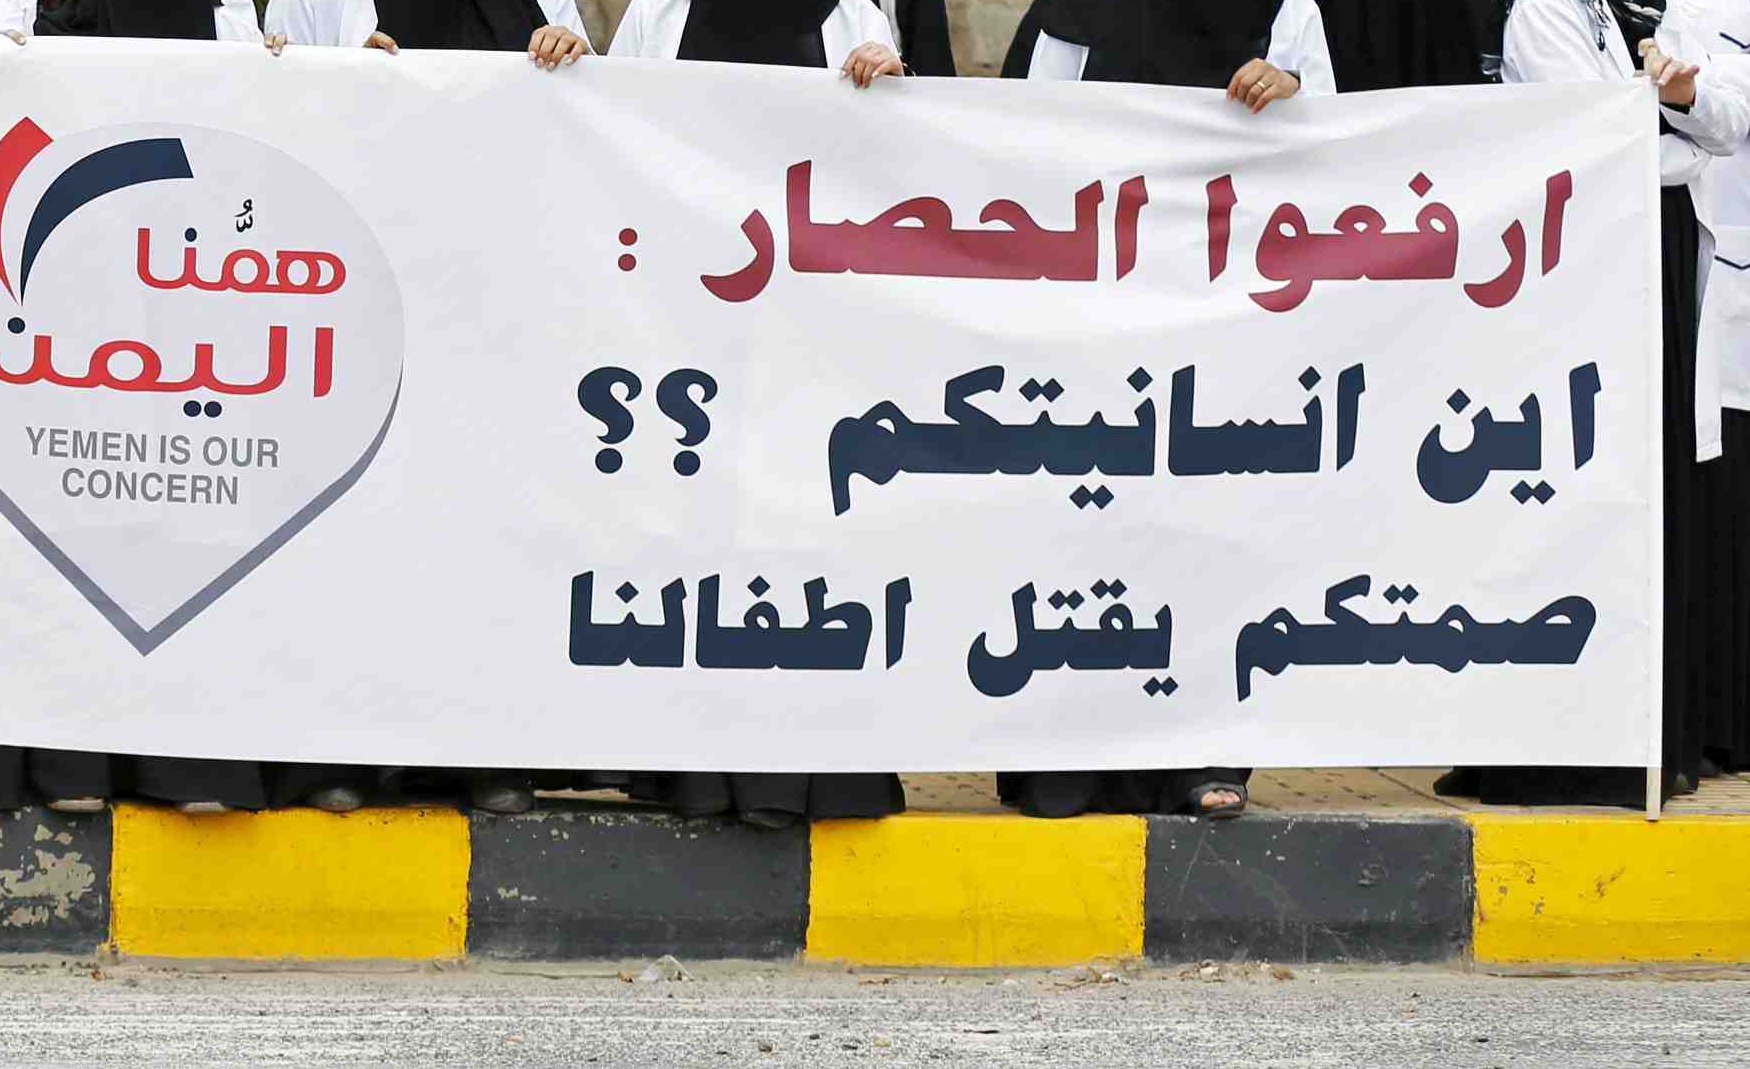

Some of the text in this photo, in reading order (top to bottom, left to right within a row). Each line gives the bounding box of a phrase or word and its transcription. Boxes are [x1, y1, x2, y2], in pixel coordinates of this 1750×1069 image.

[699, 159, 1149, 303] الحصار
[1205, 169, 1573, 313] ارفعوا
[25, 426, 279, 468] YEMEN IS OUR
[61, 467, 238, 505] CONCERN
[827, 362, 1366, 517] انسانيتكم
[1416, 361, 1602, 505] اين
[568, 570, 1597, 703] صمتكم يقتل اطفالنا
